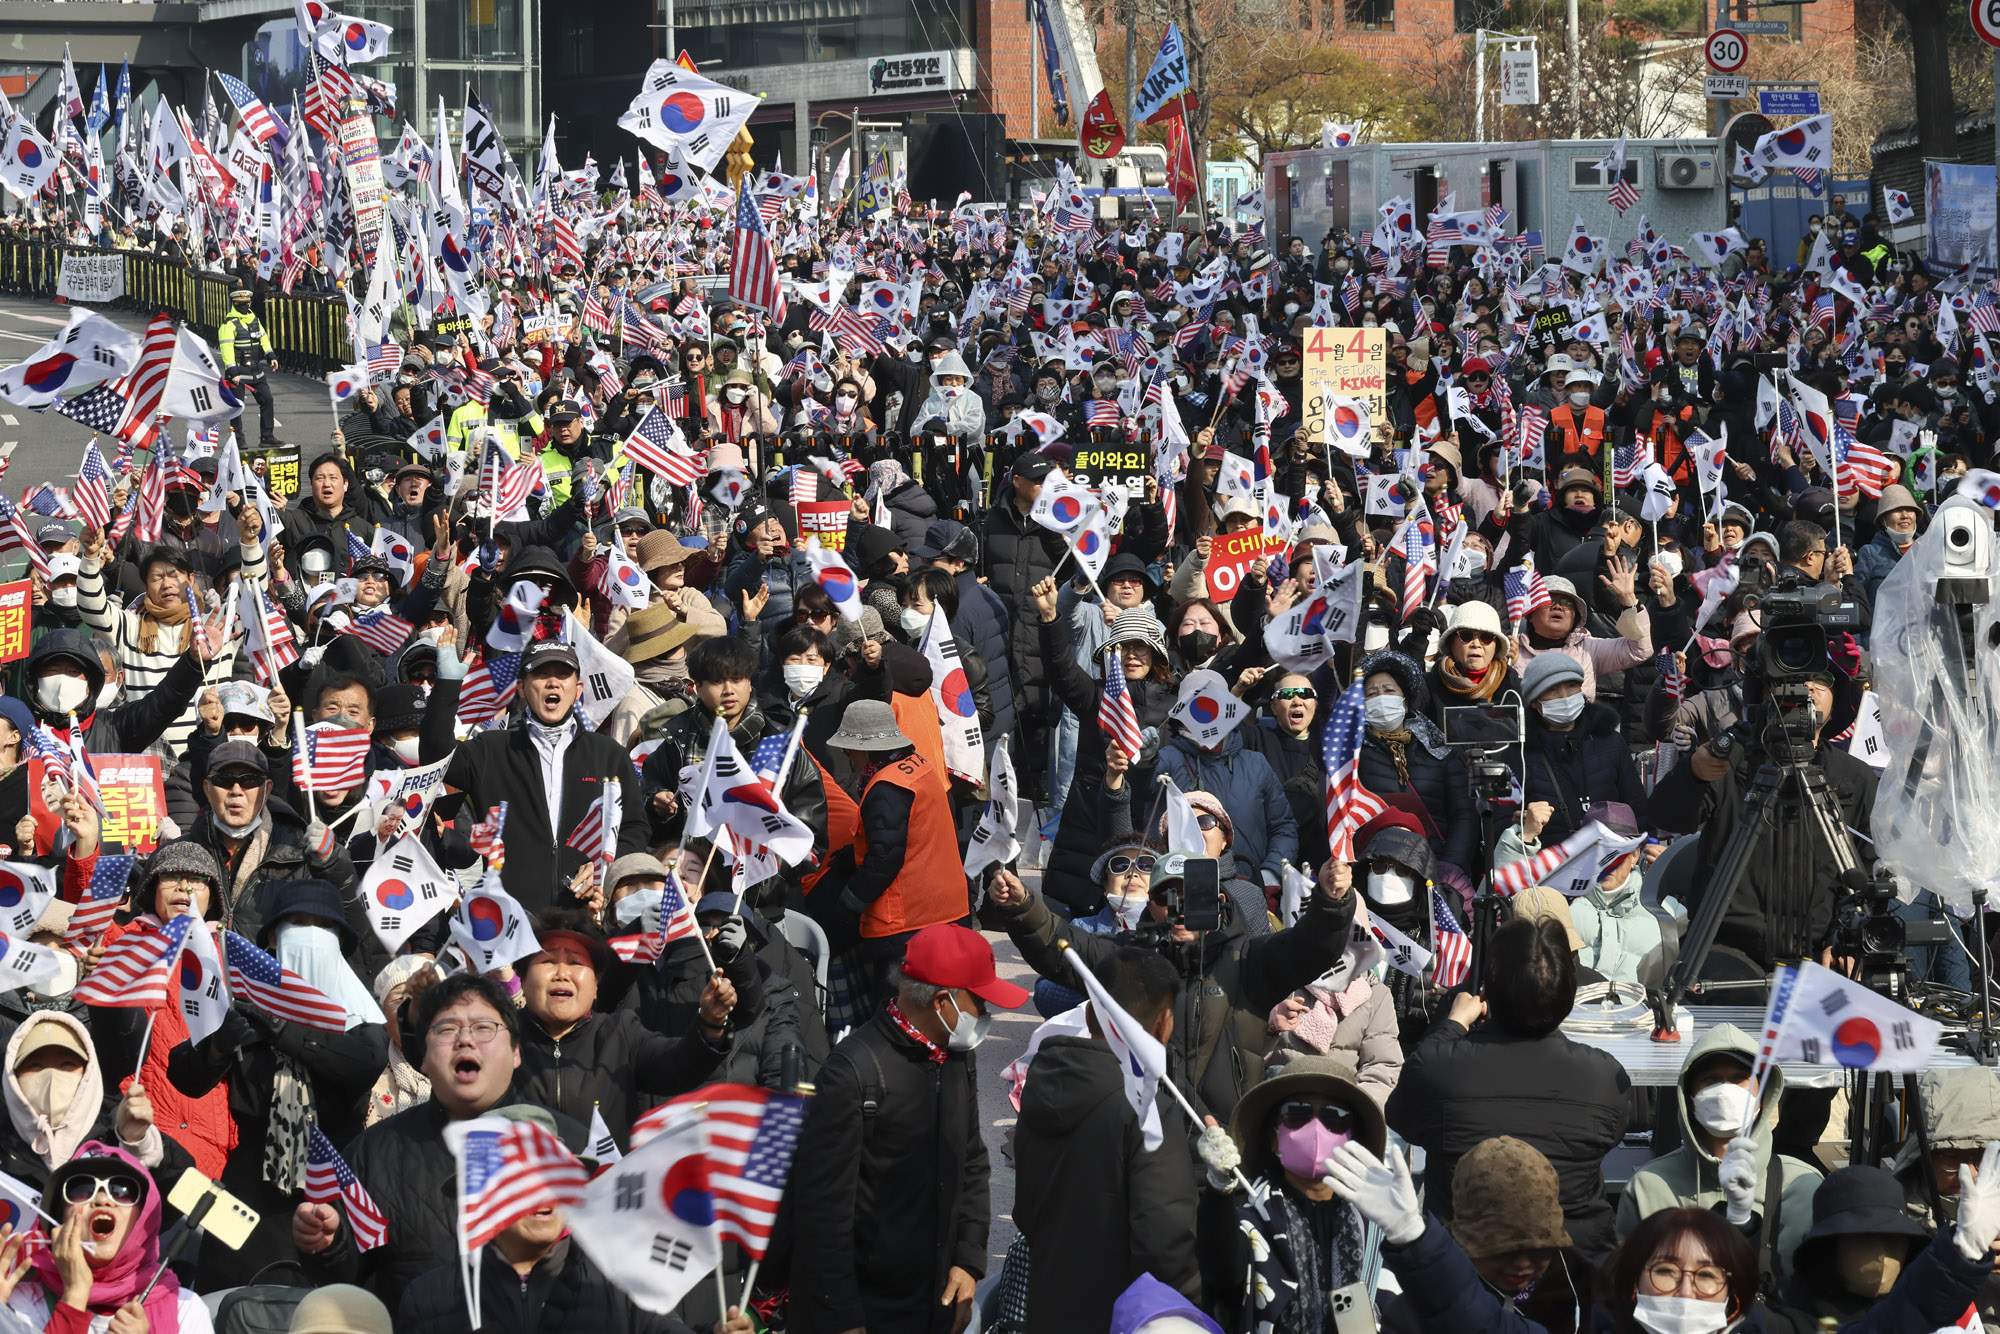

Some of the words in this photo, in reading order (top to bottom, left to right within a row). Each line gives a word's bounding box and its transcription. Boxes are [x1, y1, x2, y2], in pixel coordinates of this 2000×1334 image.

[1713, 41, 1740, 61] 30
[1707, 79, 1745, 89] 여기부터
[1771, 93, 1800, 101] 한남대로
[1306, 329, 1345, 362] 4월
[1346, 329, 1383, 363] 4일
[1309, 367, 1328, 376] The
[1335, 364, 1381, 377] RETURN
[1340, 375, 1385, 391] KING
[1075, 451, 1145, 470] 돌아와요!
[270, 461, 299, 480] 탄핵
[270, 478, 299, 496] 각하
[801, 511, 850, 531] 국민은
[1227, 533, 1284, 555] CHINA
[99, 767, 154, 785] 윤석열
[100, 786, 156, 816] 즉각
[101, 814, 157, 846] 복귀
